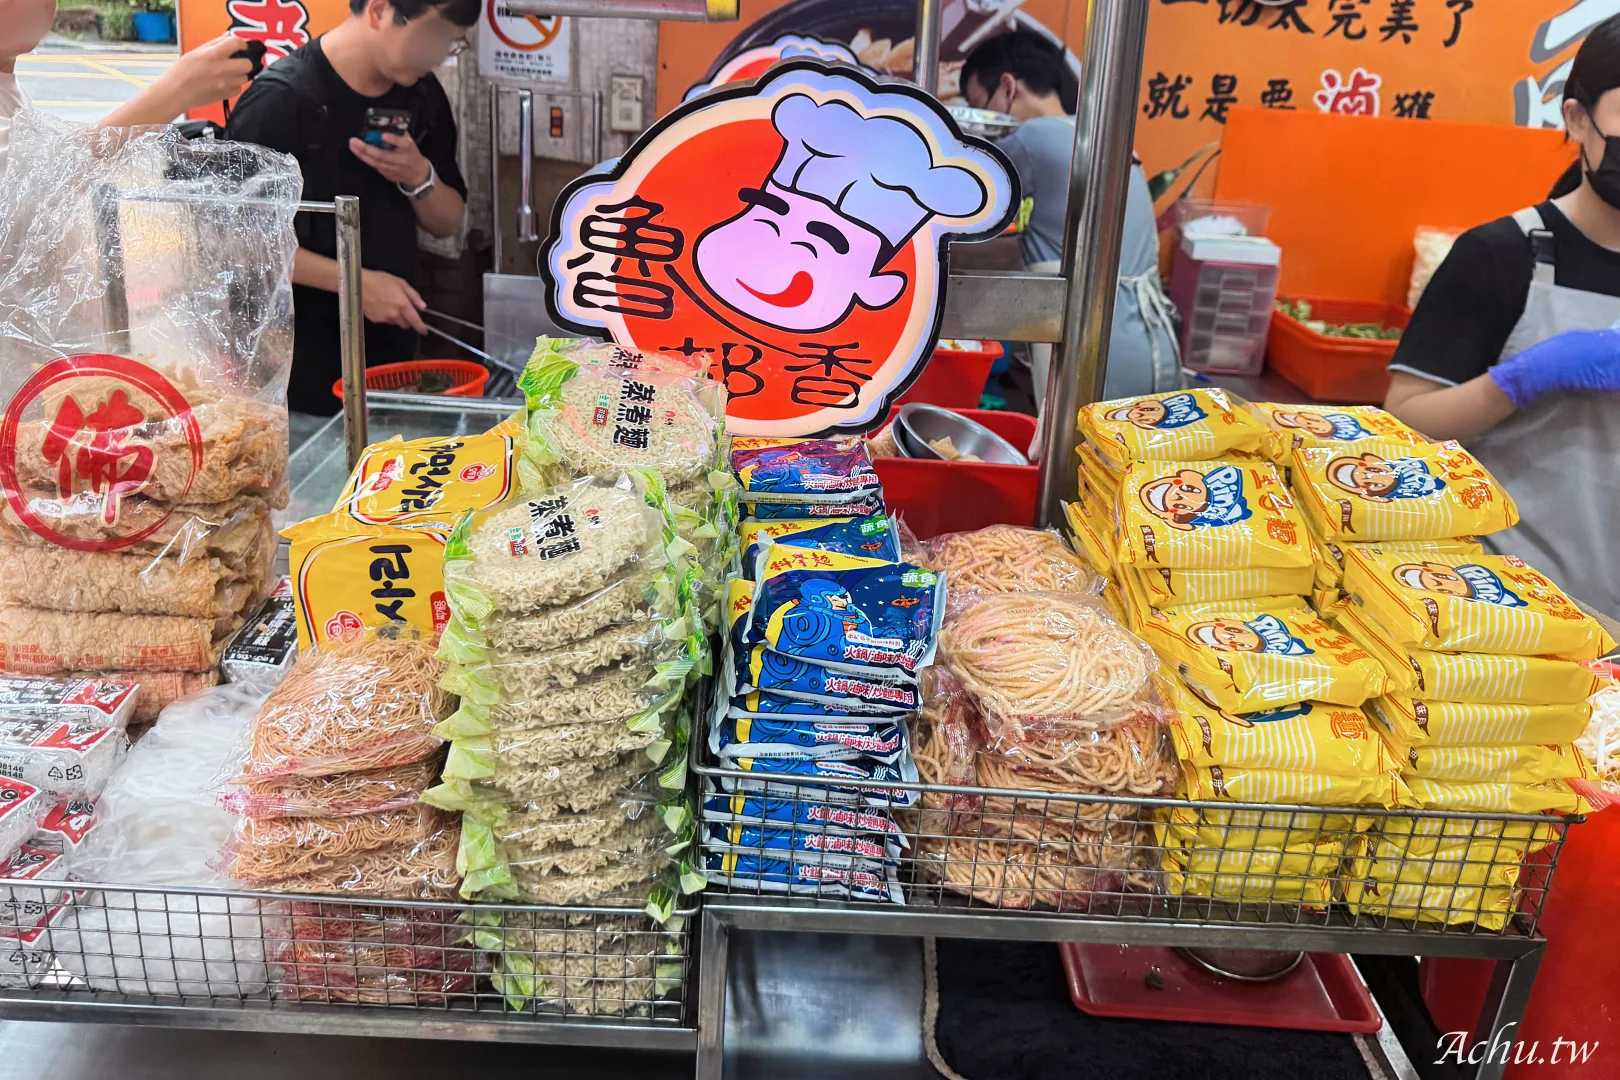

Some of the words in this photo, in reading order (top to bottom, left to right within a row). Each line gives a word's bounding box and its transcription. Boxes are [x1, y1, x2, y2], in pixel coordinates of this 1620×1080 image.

[612, 379, 656, 449] 蒸煮麵
[1163, 394, 1195, 424] Prince
[1203, 466, 1237, 520] Prince
[860, 520, 888, 533] 蔬食
[770, 552, 833, 571] 科學麵
[901, 572, 934, 583] 蔬食
[825, 678, 915, 705] 火鍋/滷味/炒麵專用
